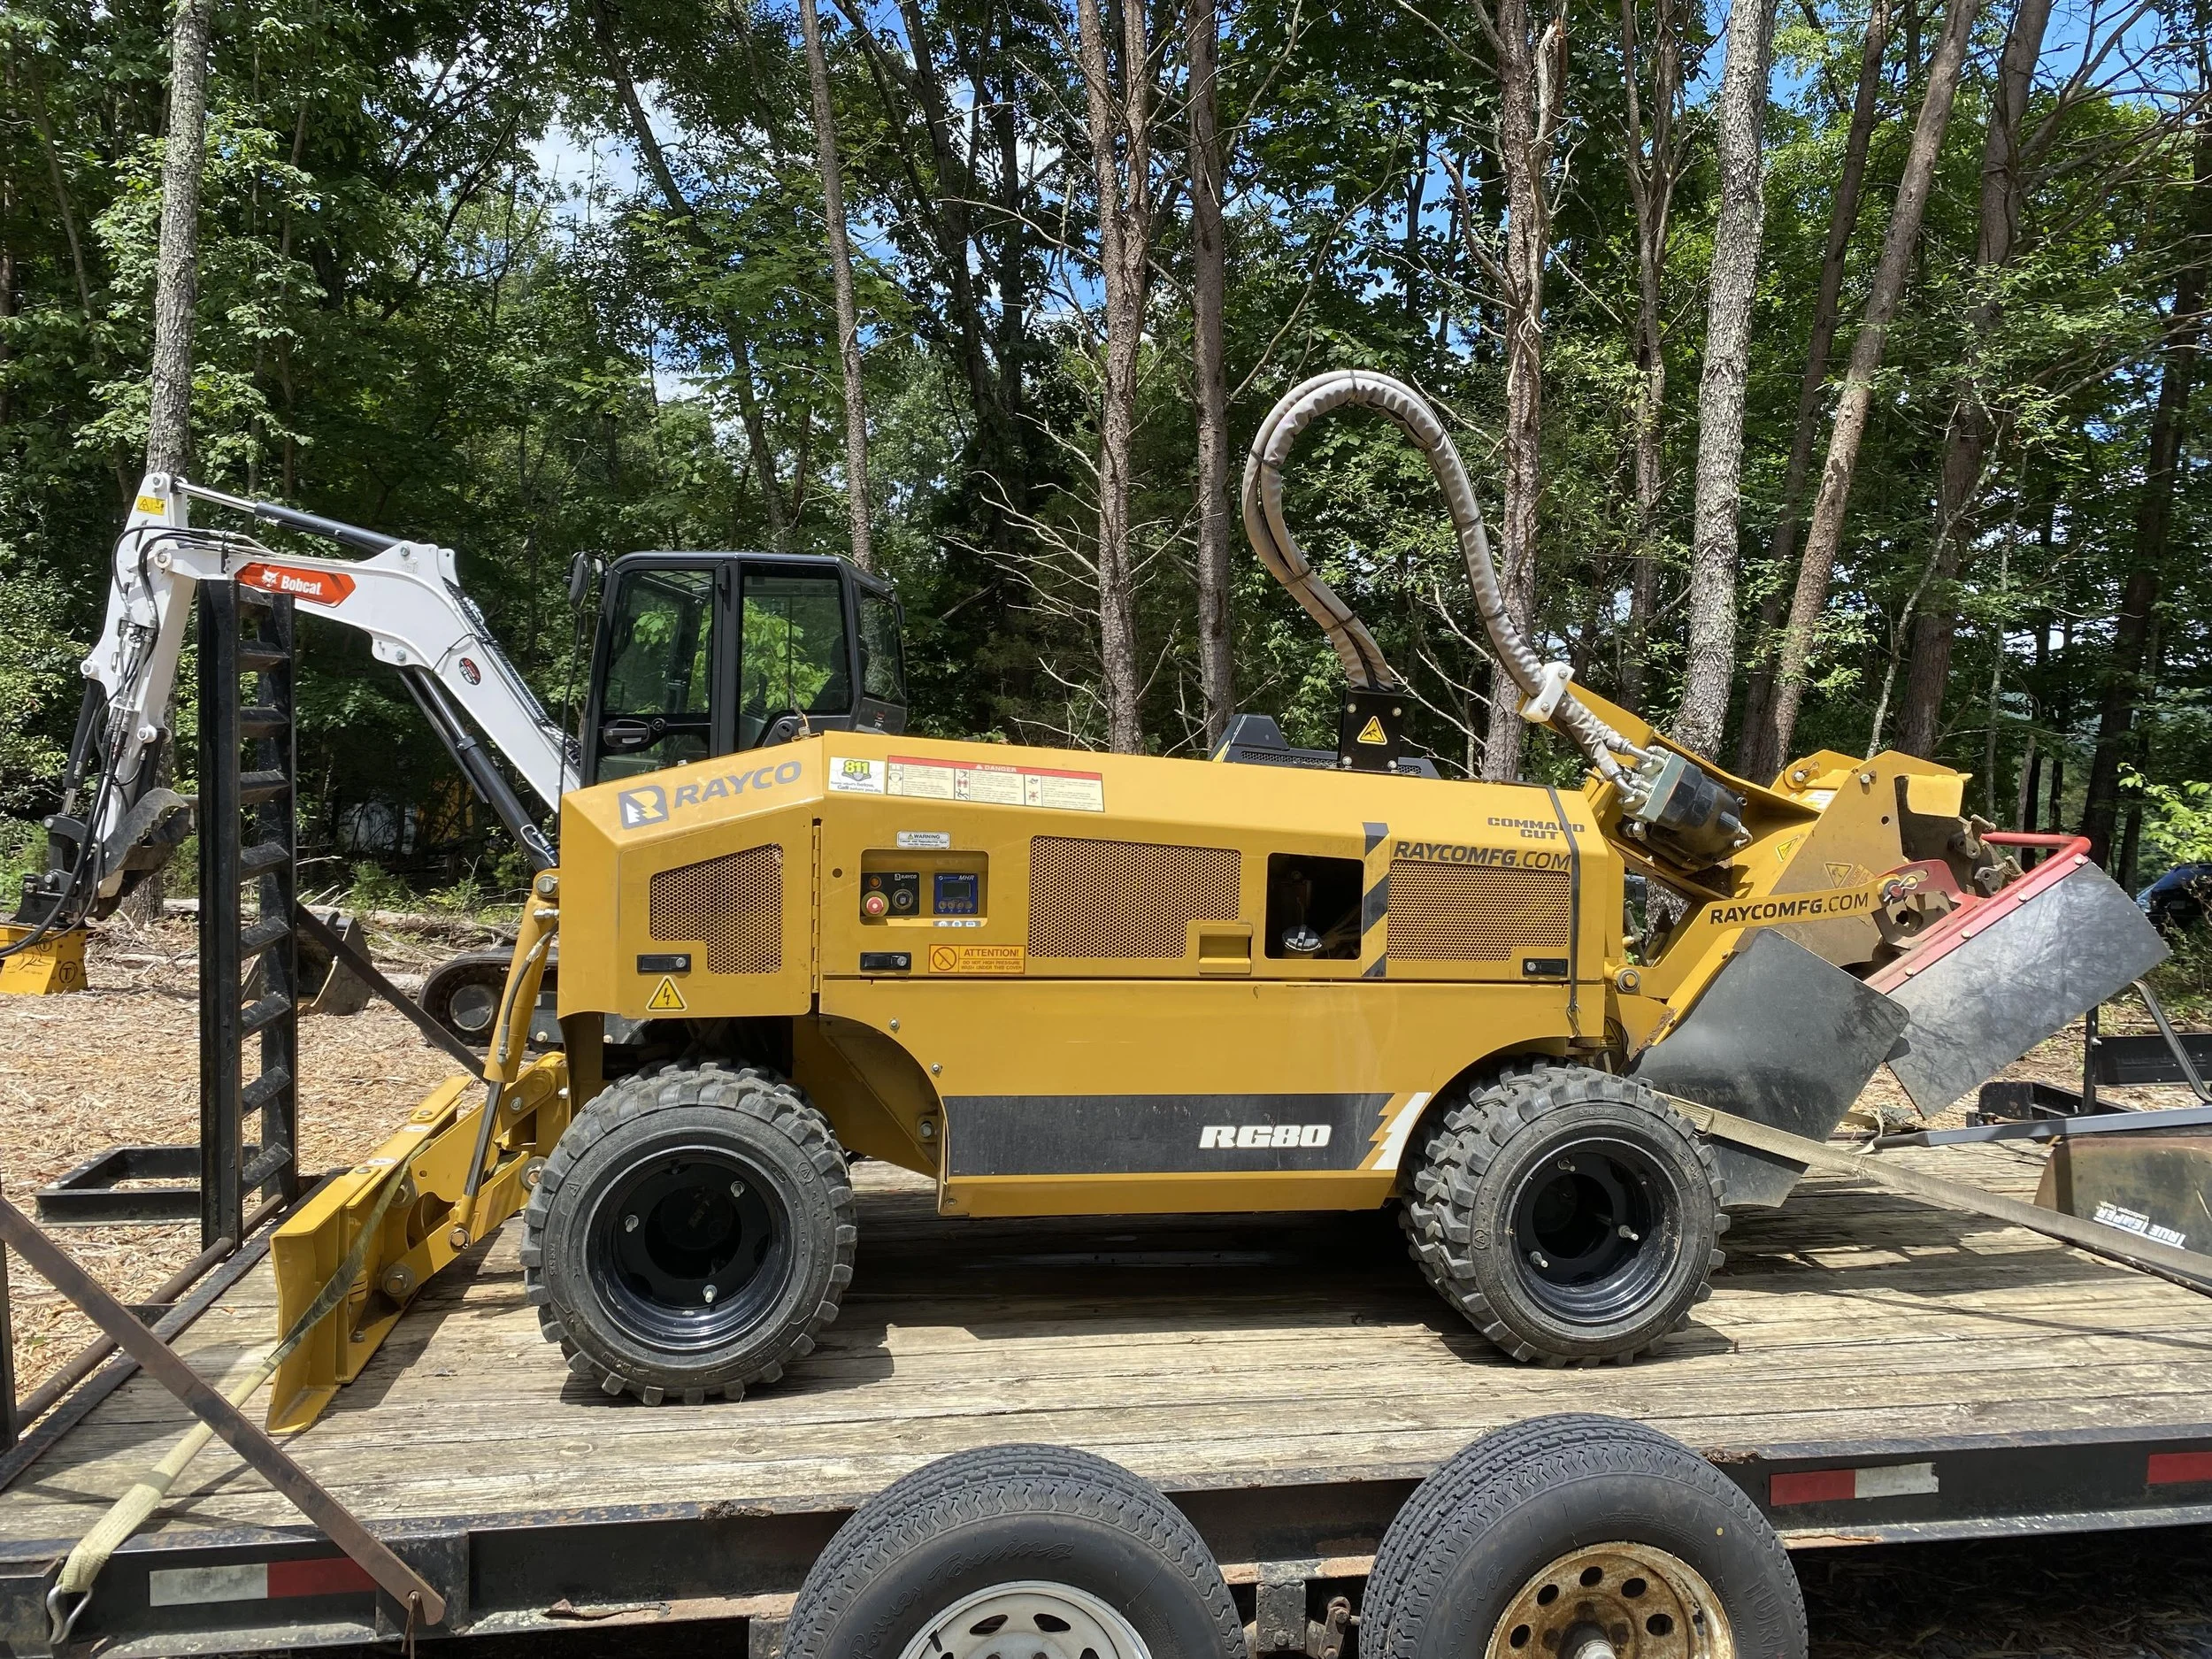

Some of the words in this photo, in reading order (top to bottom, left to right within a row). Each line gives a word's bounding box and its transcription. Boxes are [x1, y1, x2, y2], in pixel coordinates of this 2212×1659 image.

[280, 575, 322, 595] Bobcat
[843, 759, 870, 774] 811
[674, 761, 802, 809] RAYCO
[1520, 829, 1559, 840] CUT
[1394, 841, 1571, 870] RAYCOMFG.COM
[1709, 892, 1869, 925] RAYCOMFG.COM
[1198, 1125, 1333, 1149] RG80
[2093, 1205, 2149, 1238] TEMPER
[2147, 1224, 2186, 1249] TRUE
